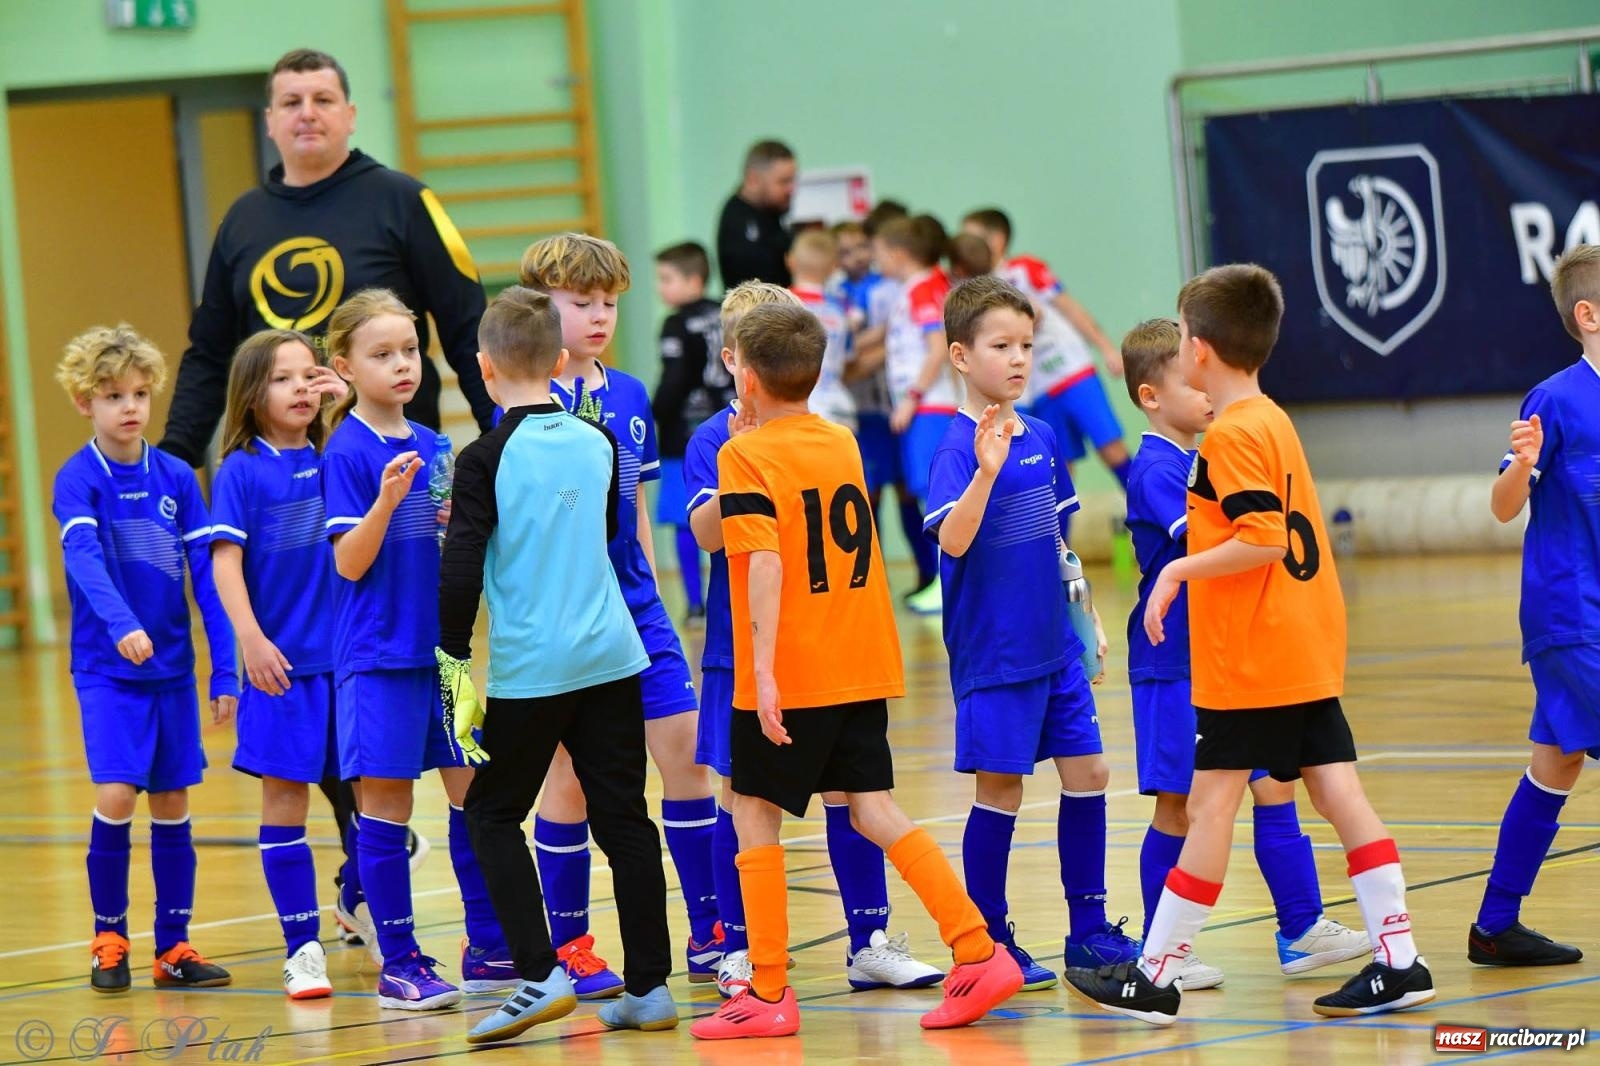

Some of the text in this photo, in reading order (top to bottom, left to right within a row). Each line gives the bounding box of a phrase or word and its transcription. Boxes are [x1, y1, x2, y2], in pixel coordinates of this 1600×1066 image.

[801, 484, 872, 593] 19
[1282, 473, 1320, 581] 6
[160, 961, 184, 978] FILA
